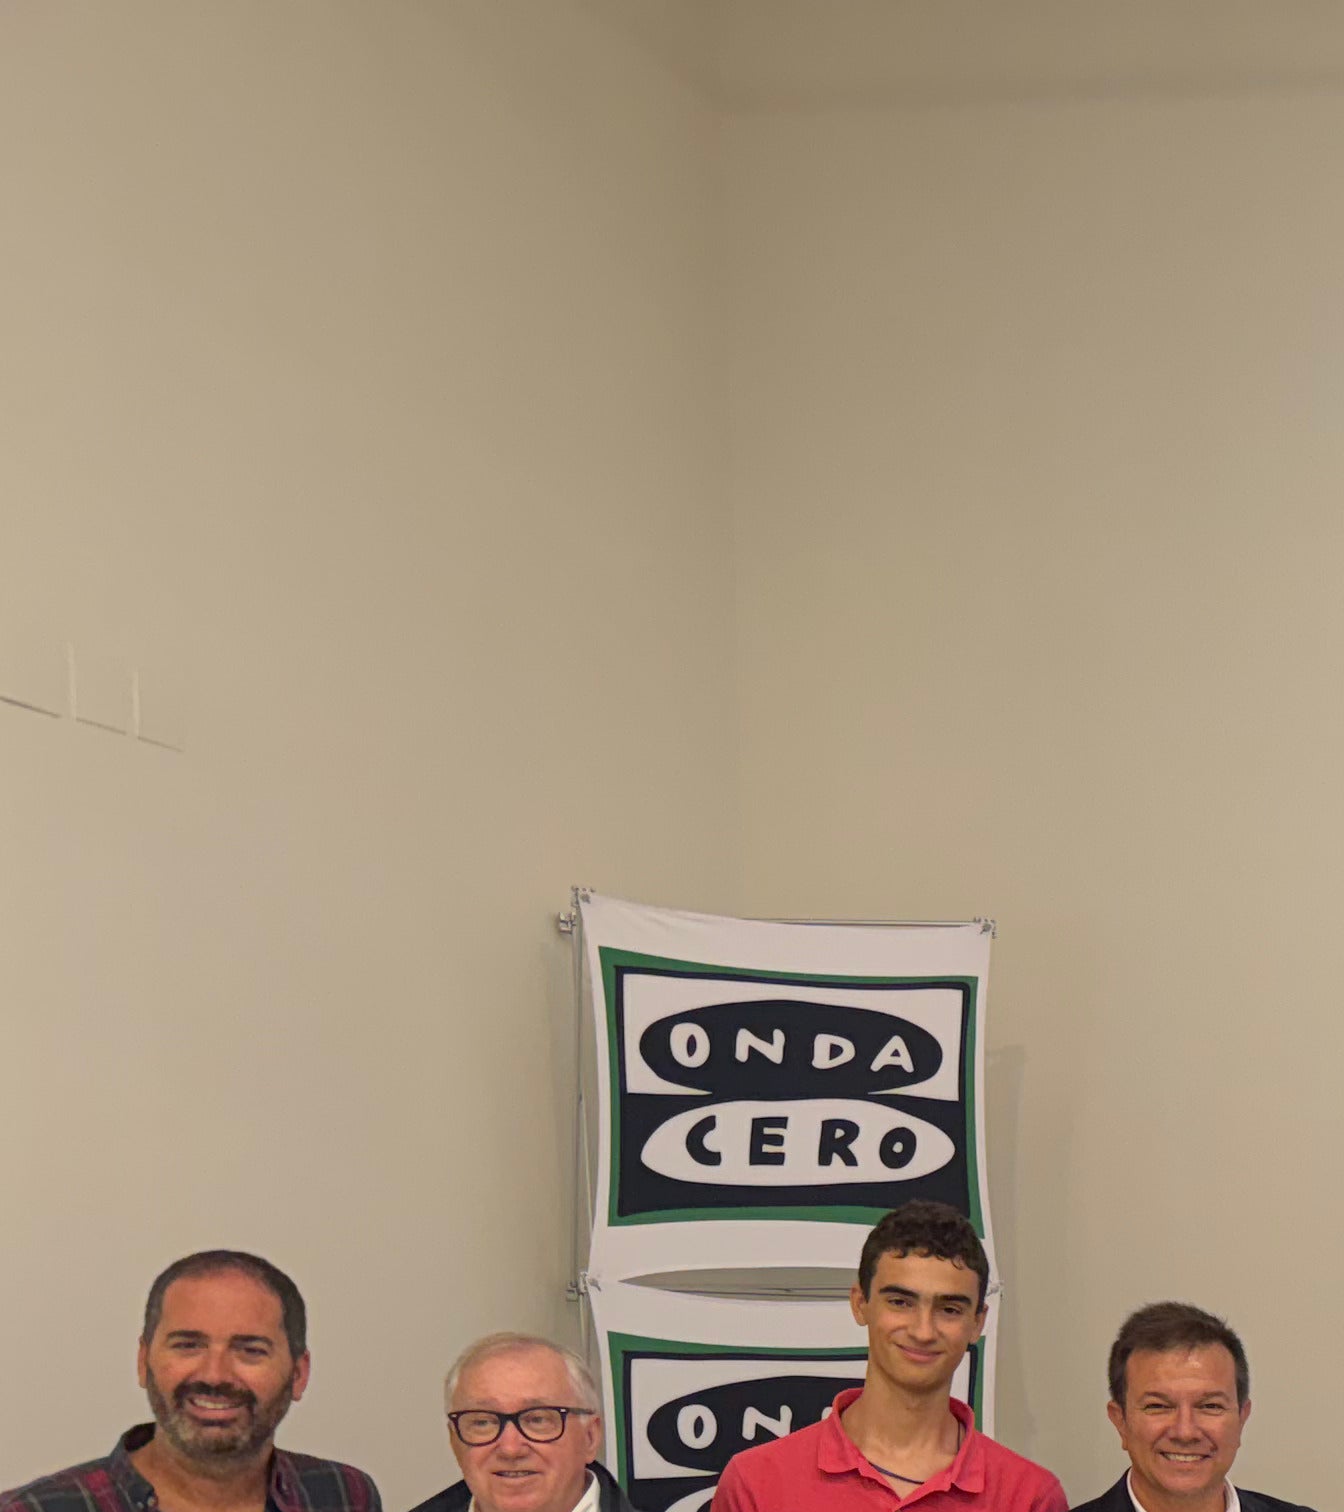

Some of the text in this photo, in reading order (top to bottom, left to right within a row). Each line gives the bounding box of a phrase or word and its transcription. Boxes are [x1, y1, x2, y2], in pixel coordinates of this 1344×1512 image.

[669, 1021, 915, 1074] ONDA
[685, 1115, 917, 1169] CERO
[676, 1403, 832, 1450] ON
